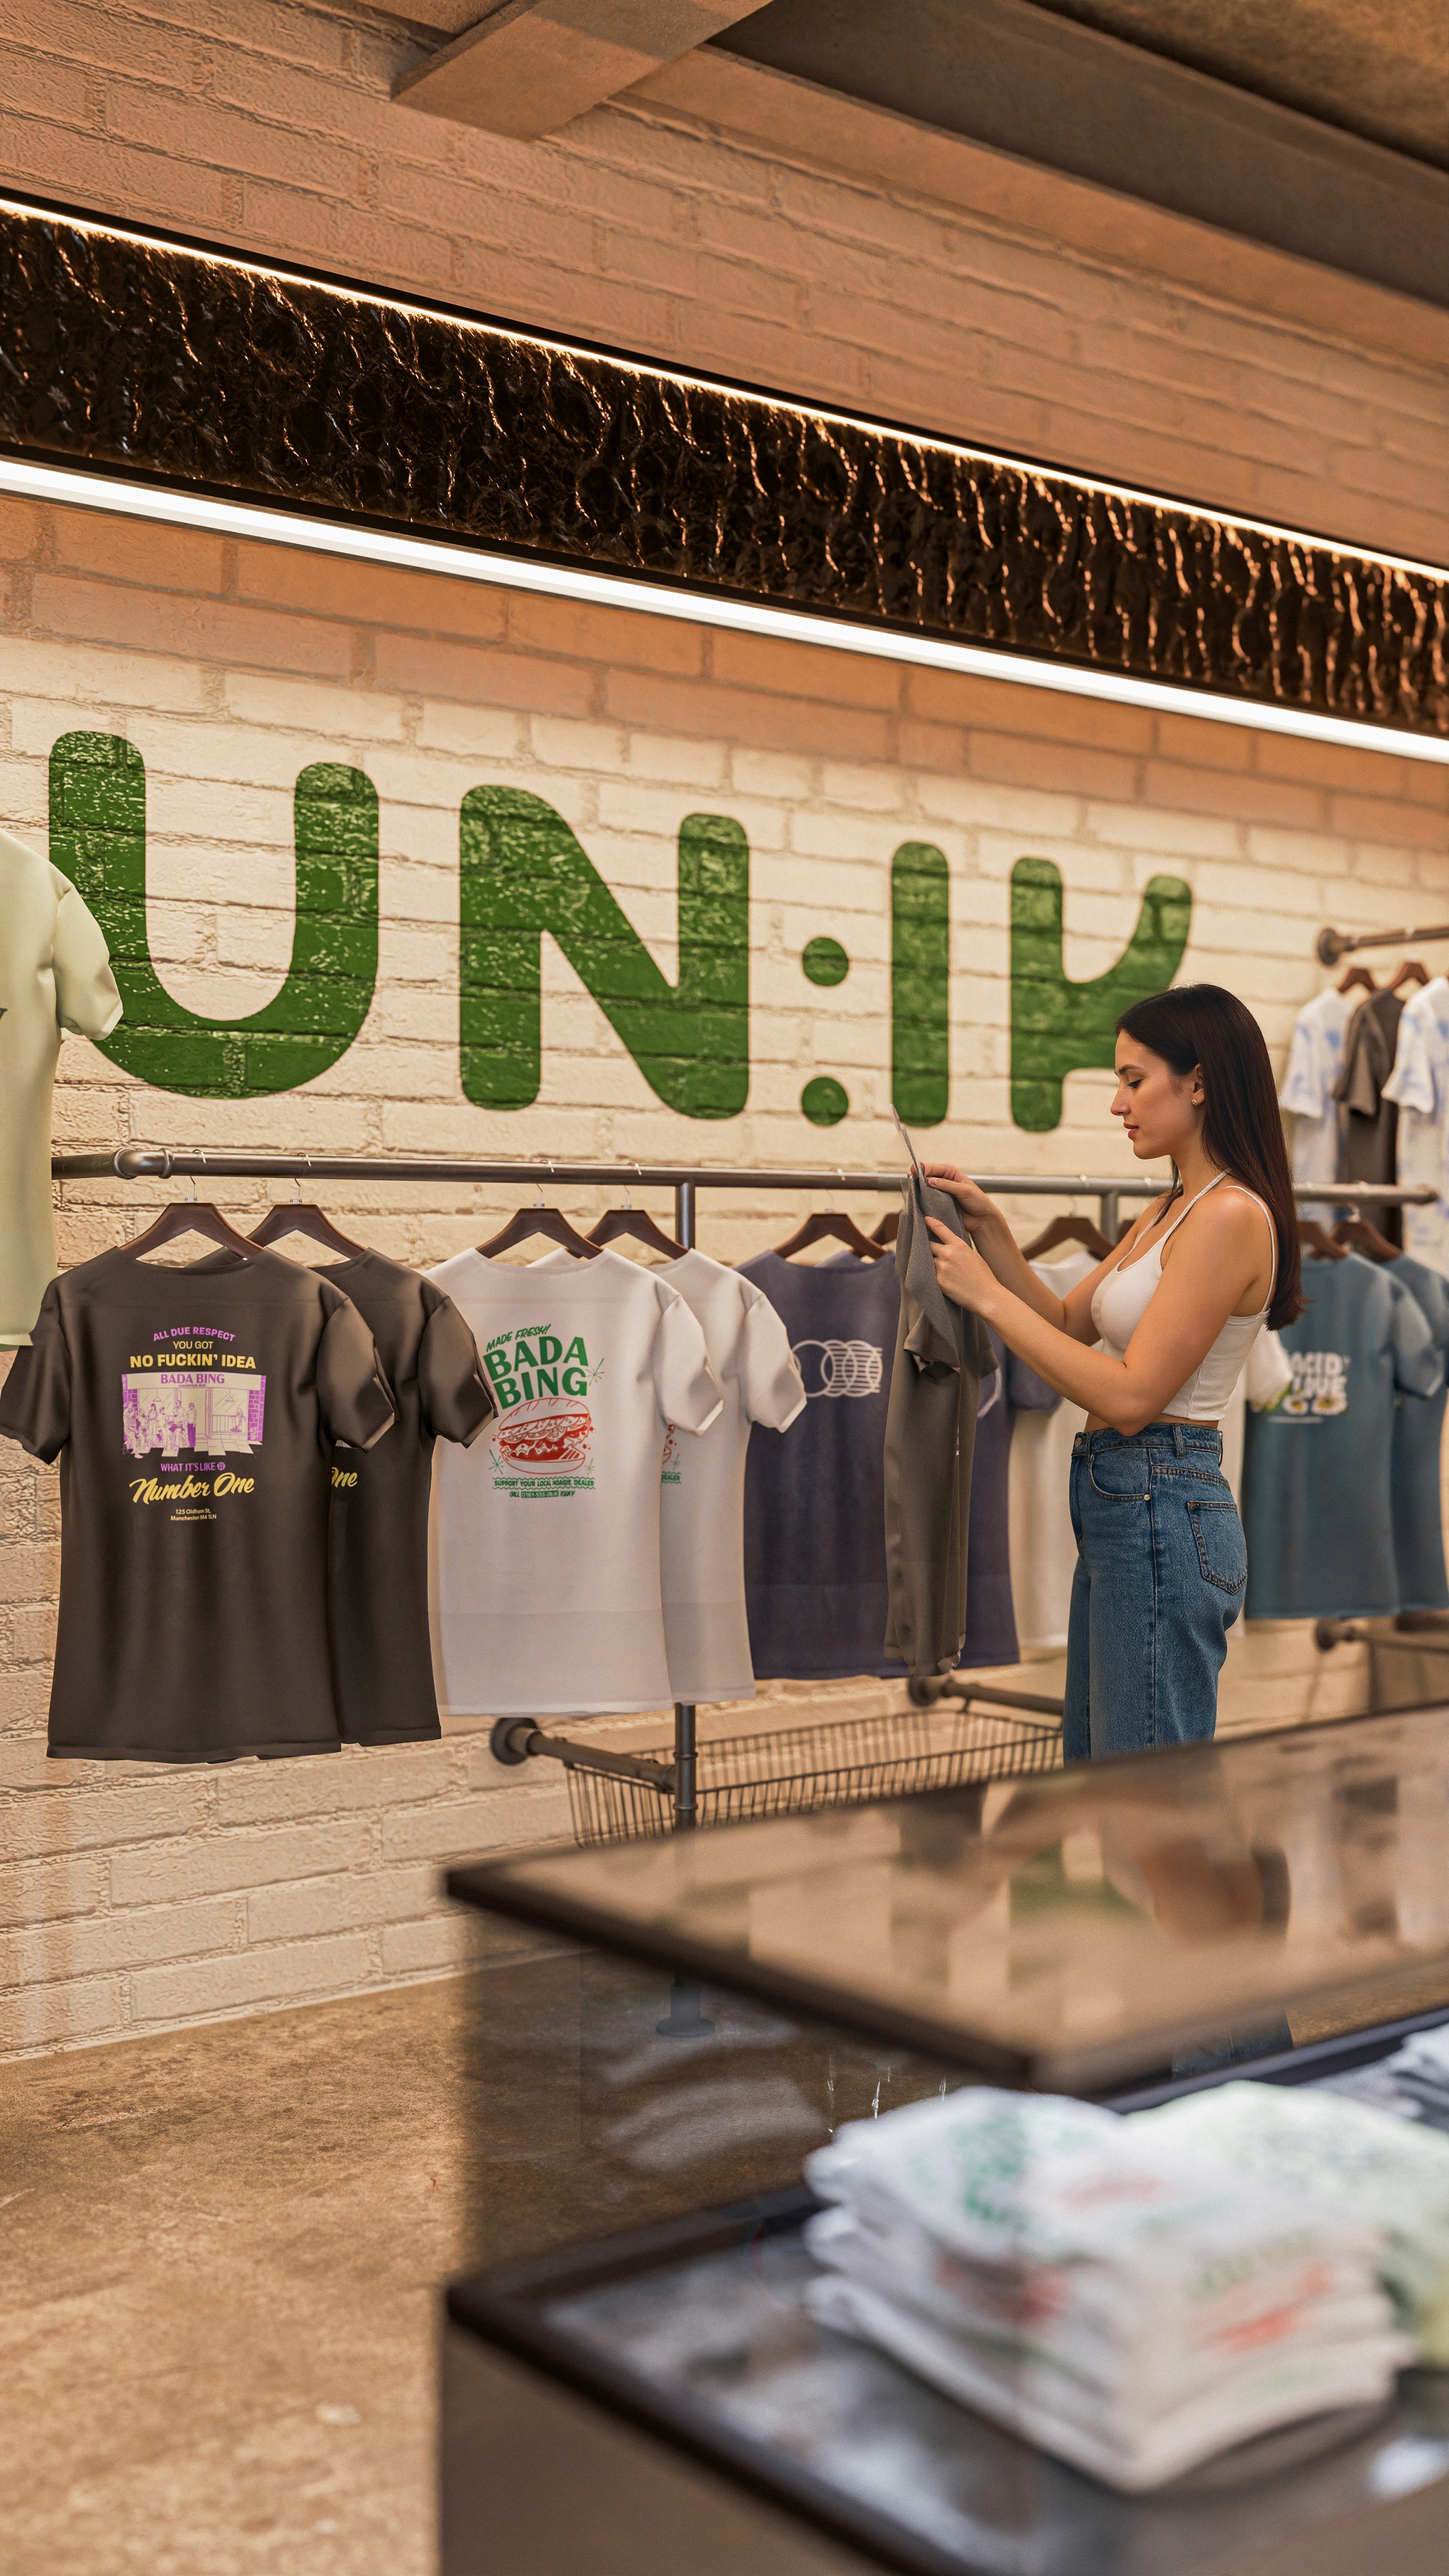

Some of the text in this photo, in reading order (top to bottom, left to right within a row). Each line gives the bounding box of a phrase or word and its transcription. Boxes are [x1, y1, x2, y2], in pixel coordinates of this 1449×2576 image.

[153, 1326, 235, 1341] ALL DUE RESPECT
[485, 1323, 551, 1352] MADE FRESH!
[173, 1341, 214, 1349] YOU GOT
[130, 1354, 153, 1368] NO
[222, 1354, 256, 1369] IDEA
[483, 1336, 589, 1381] BADA
[161, 1373, 224, 1384] BADA BING
[493, 1367, 587, 1410] BING
[160, 1462, 216, 1472] WHAT IT'S LIKE
[129, 1472, 255, 1504] Number One
